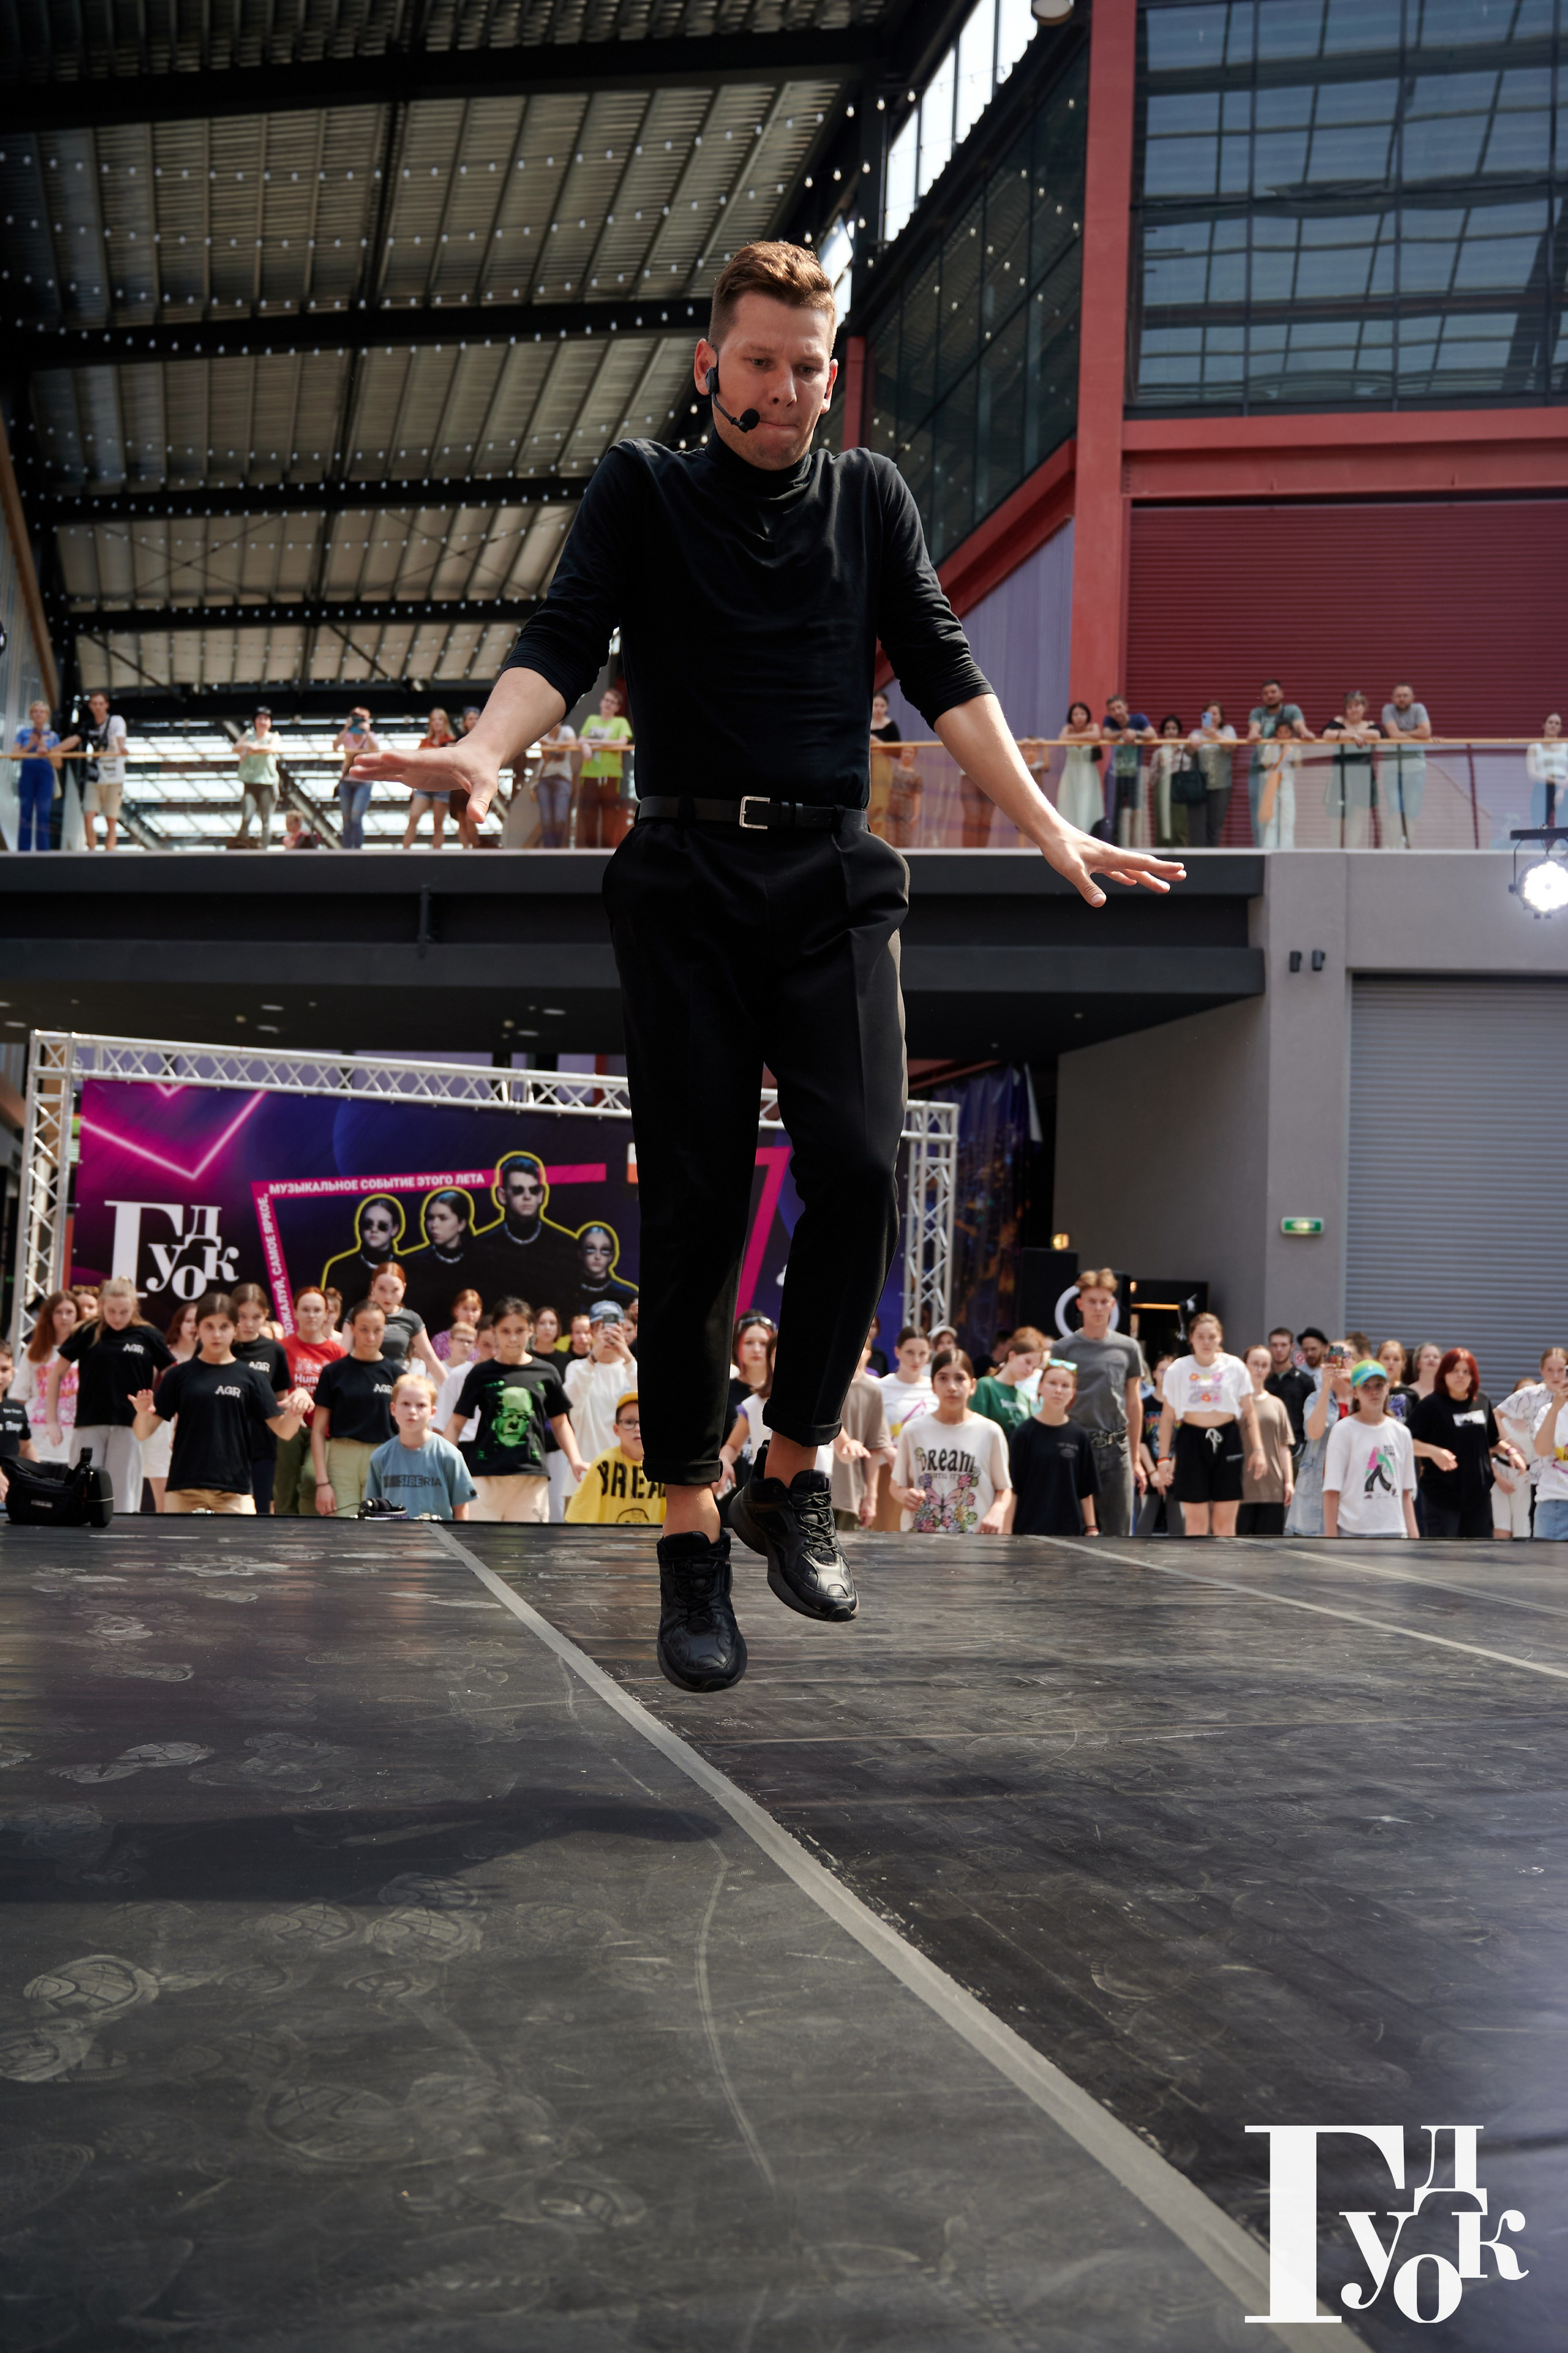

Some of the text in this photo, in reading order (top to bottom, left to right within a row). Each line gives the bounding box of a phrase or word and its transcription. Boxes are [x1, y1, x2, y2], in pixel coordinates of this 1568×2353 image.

[269, 1173, 484, 1194] МУЗЫКАЛЬНОЕ СОБЫТИЕ ЭТОГО ЛЕТА
[257, 1193, 274, 1234] ЯРКОЕ,
[266, 1234, 282, 1276] САМОЕ
[249, 1361, 270, 1372] AGR
[295, 1373, 318, 1384] Hum
[215, 1385, 241, 1398] AGR
[399, 1475, 442, 1487] SIBERIA
